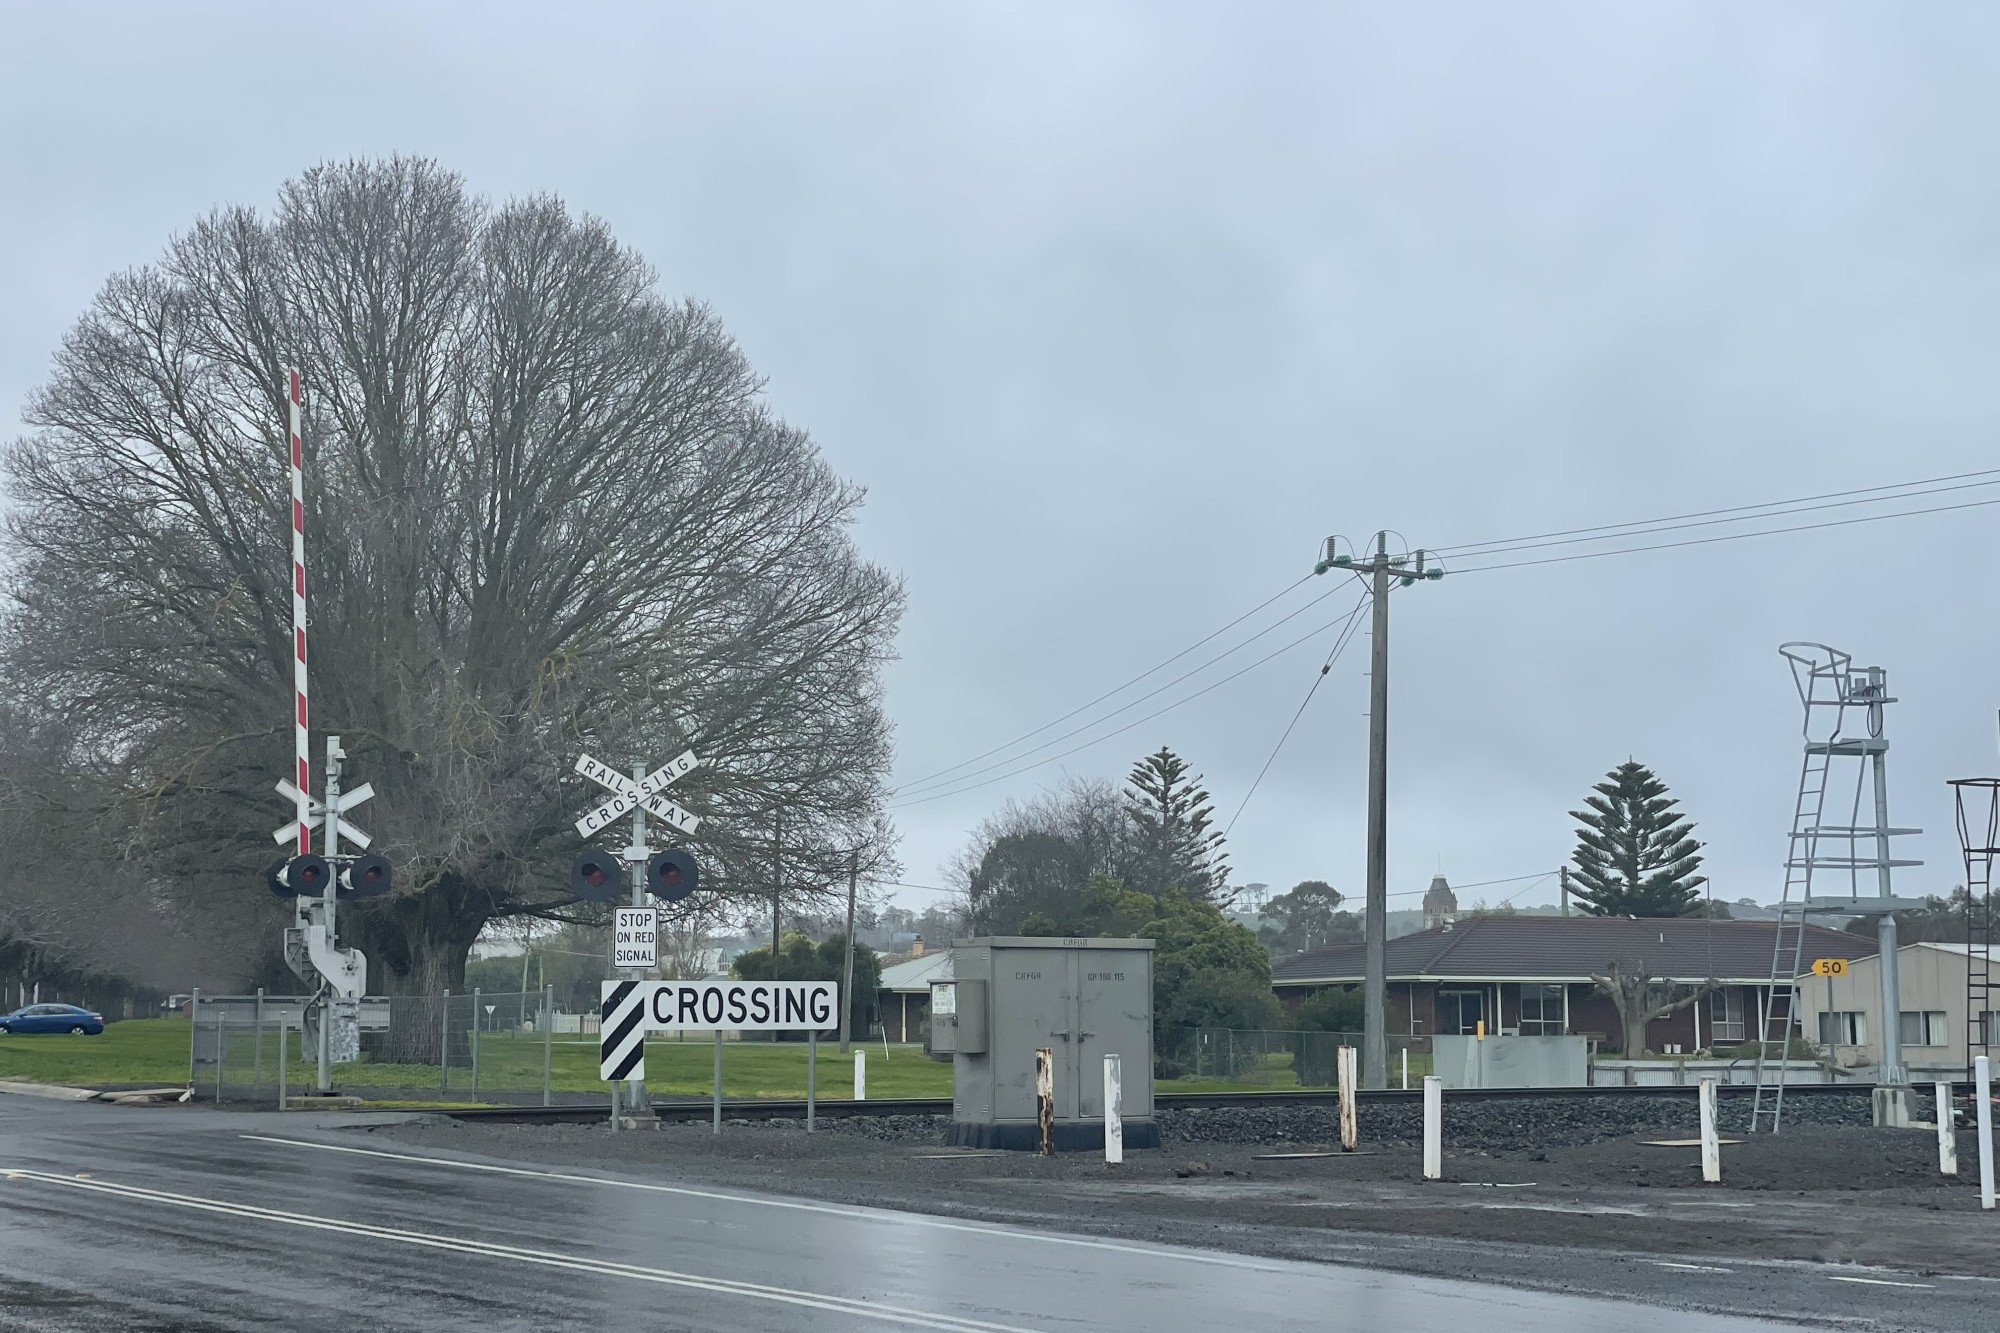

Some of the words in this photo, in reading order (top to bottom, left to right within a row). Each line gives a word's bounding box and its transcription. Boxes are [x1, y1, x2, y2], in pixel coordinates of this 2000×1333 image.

[586, 758, 689, 830] CROSSING
[620, 913, 652, 927] STOP
[617, 931, 631, 943] ON
[635, 931, 655, 943] RED
[616, 949, 654, 962] SIGNAL
[1822, 961, 1842, 974] 50
[653, 986, 830, 1024] CROSSING
